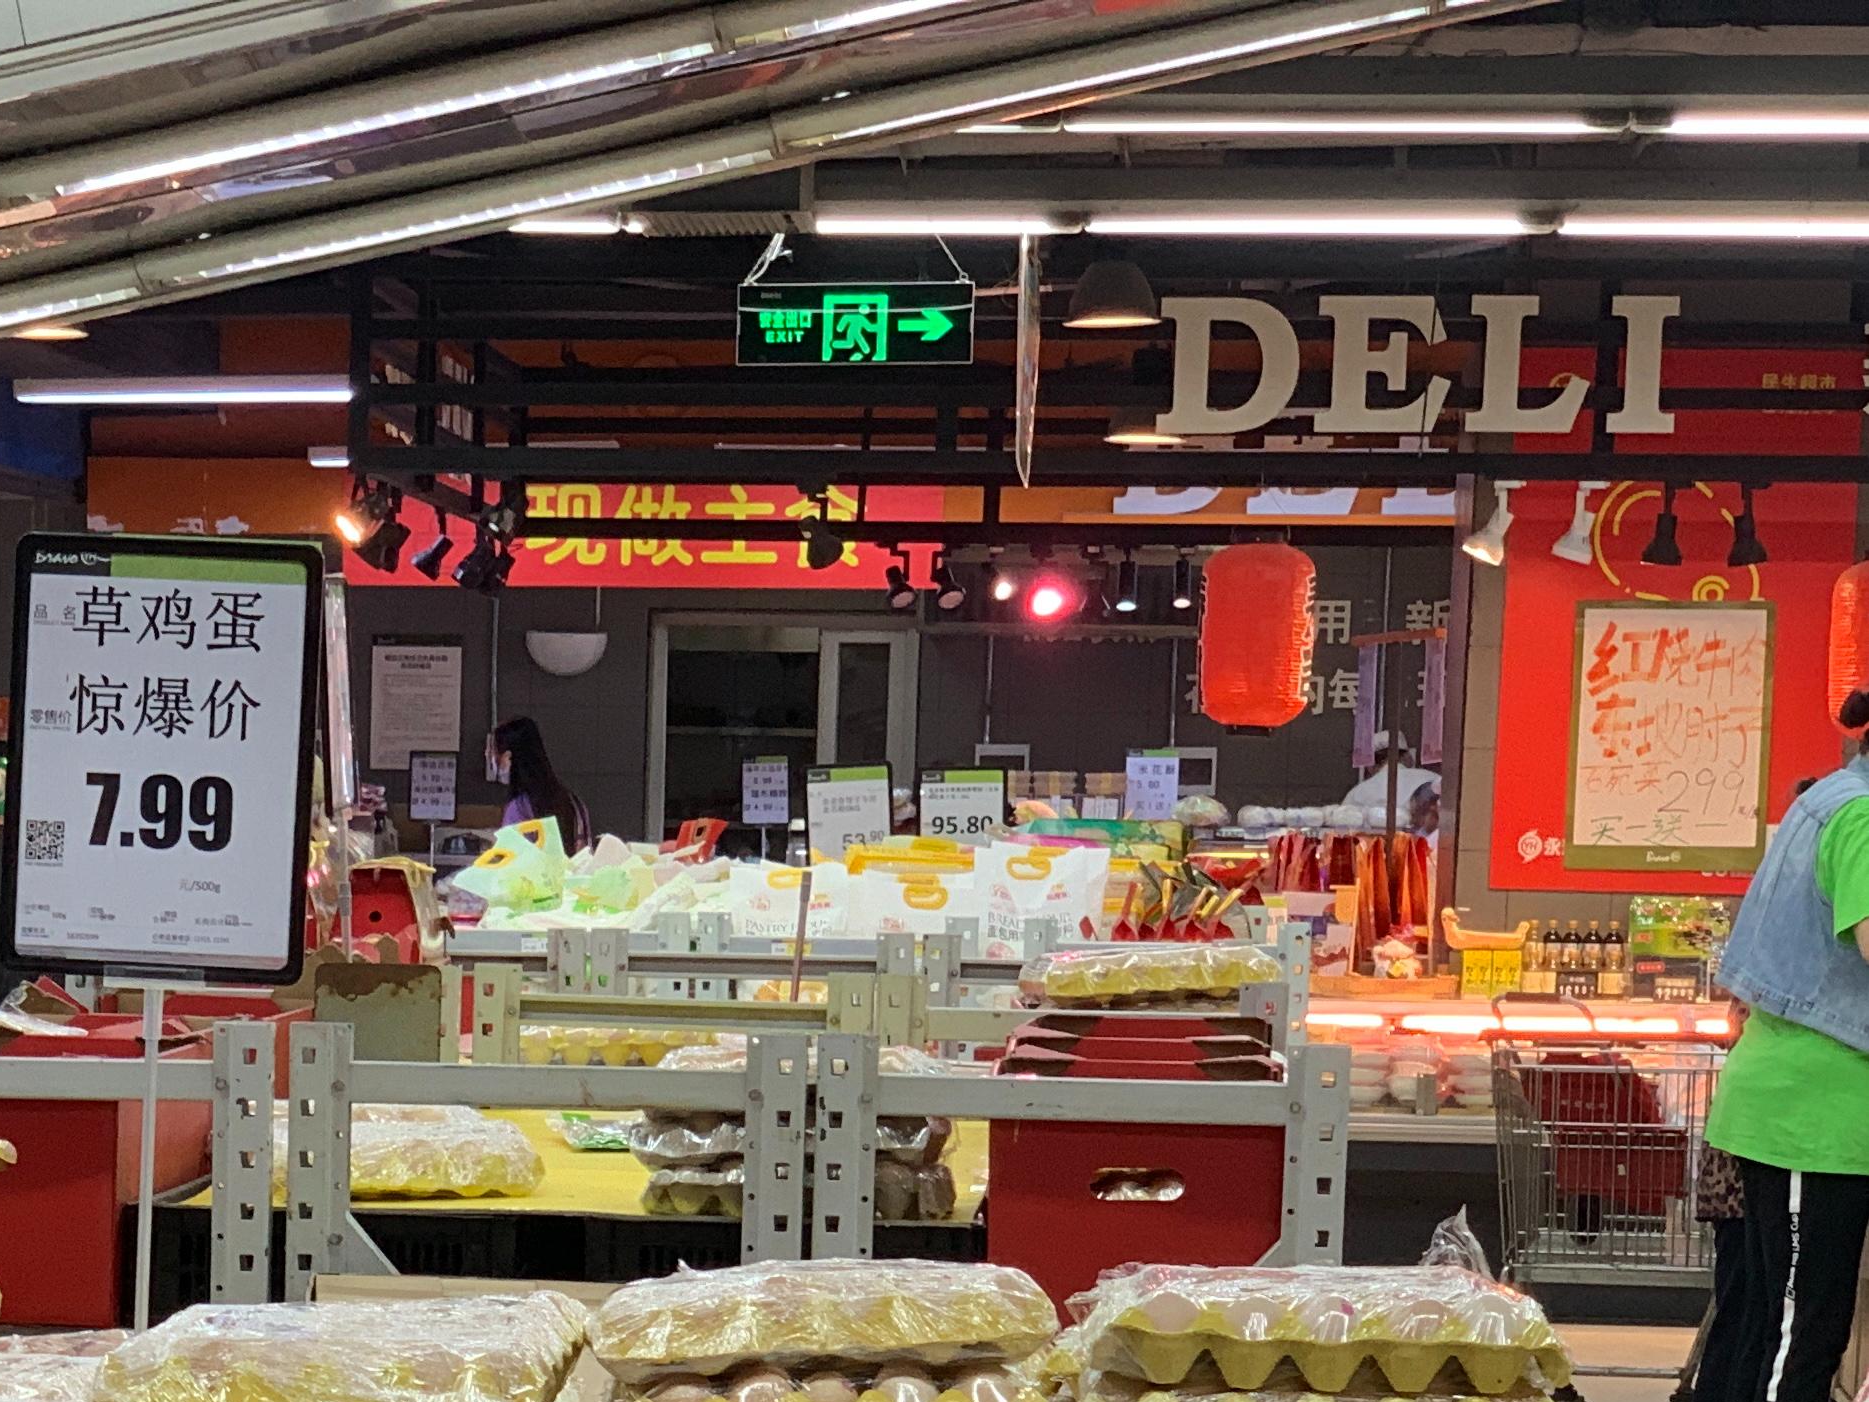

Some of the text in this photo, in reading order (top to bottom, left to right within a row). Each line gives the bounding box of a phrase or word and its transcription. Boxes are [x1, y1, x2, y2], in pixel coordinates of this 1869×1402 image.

[765, 330, 804, 343] EXIT
[1156, 294, 1680, 435] DELI
[73, 585, 265, 652] 草鸡蛋
[69, 672, 261, 741] 惊爆价
[86, 772, 234, 852] 7.99
